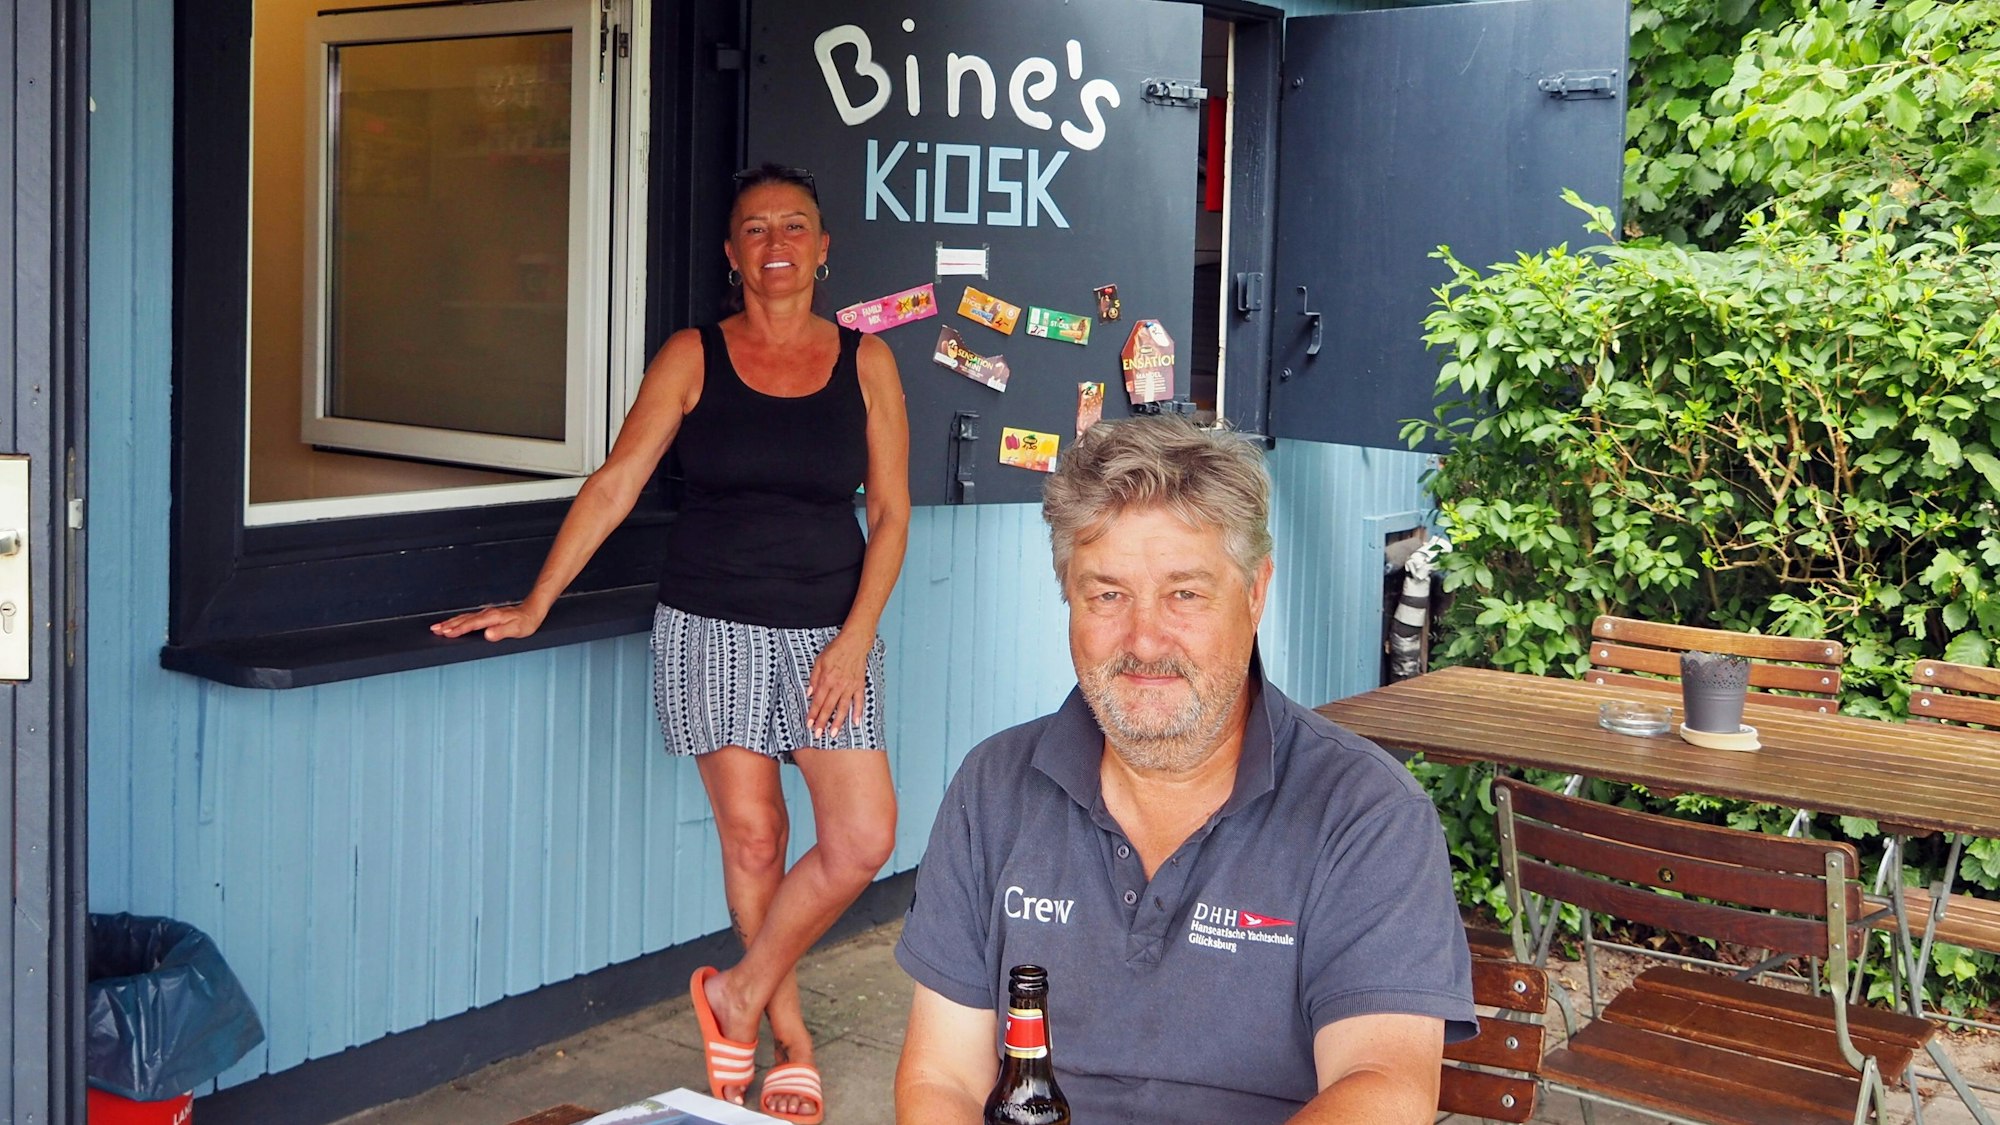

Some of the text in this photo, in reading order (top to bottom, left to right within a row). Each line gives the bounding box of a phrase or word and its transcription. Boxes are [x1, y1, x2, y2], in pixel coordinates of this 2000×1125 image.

[814, 18, 1121, 151] Bine's
[865, 139, 1070, 229] KiOSK
[1003, 885, 1075, 924] Crew
[1193, 902, 1238, 927] DHH
[1188, 932, 1238, 953] Glücksburg
[1190, 919, 1295, 946] Hanseatische Yachtschule
